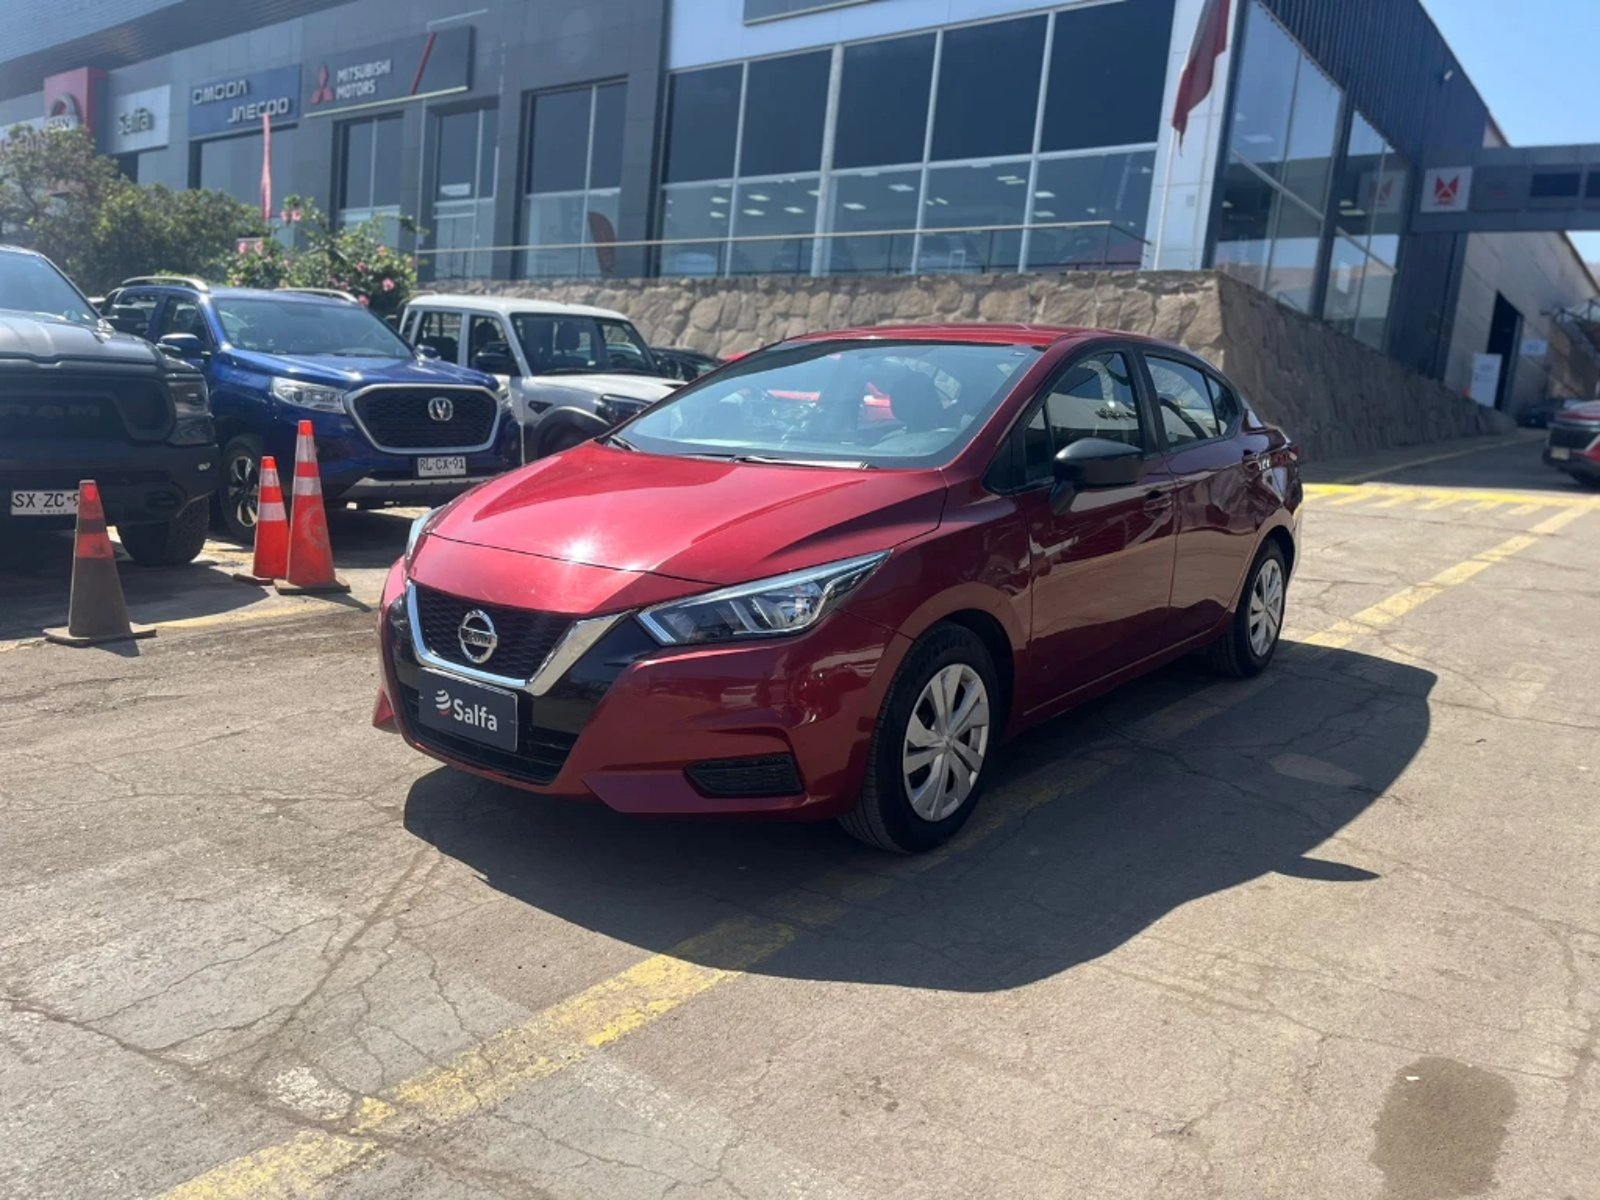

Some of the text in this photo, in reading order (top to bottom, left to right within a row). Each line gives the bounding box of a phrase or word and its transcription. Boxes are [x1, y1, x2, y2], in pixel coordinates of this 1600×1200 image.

[337, 59, 392, 83] MITSUBISHI
[336, 79, 376, 99] MOTORS
[227, 97, 289, 124] JAECOO
[453, 699, 498, 732] Salfa
